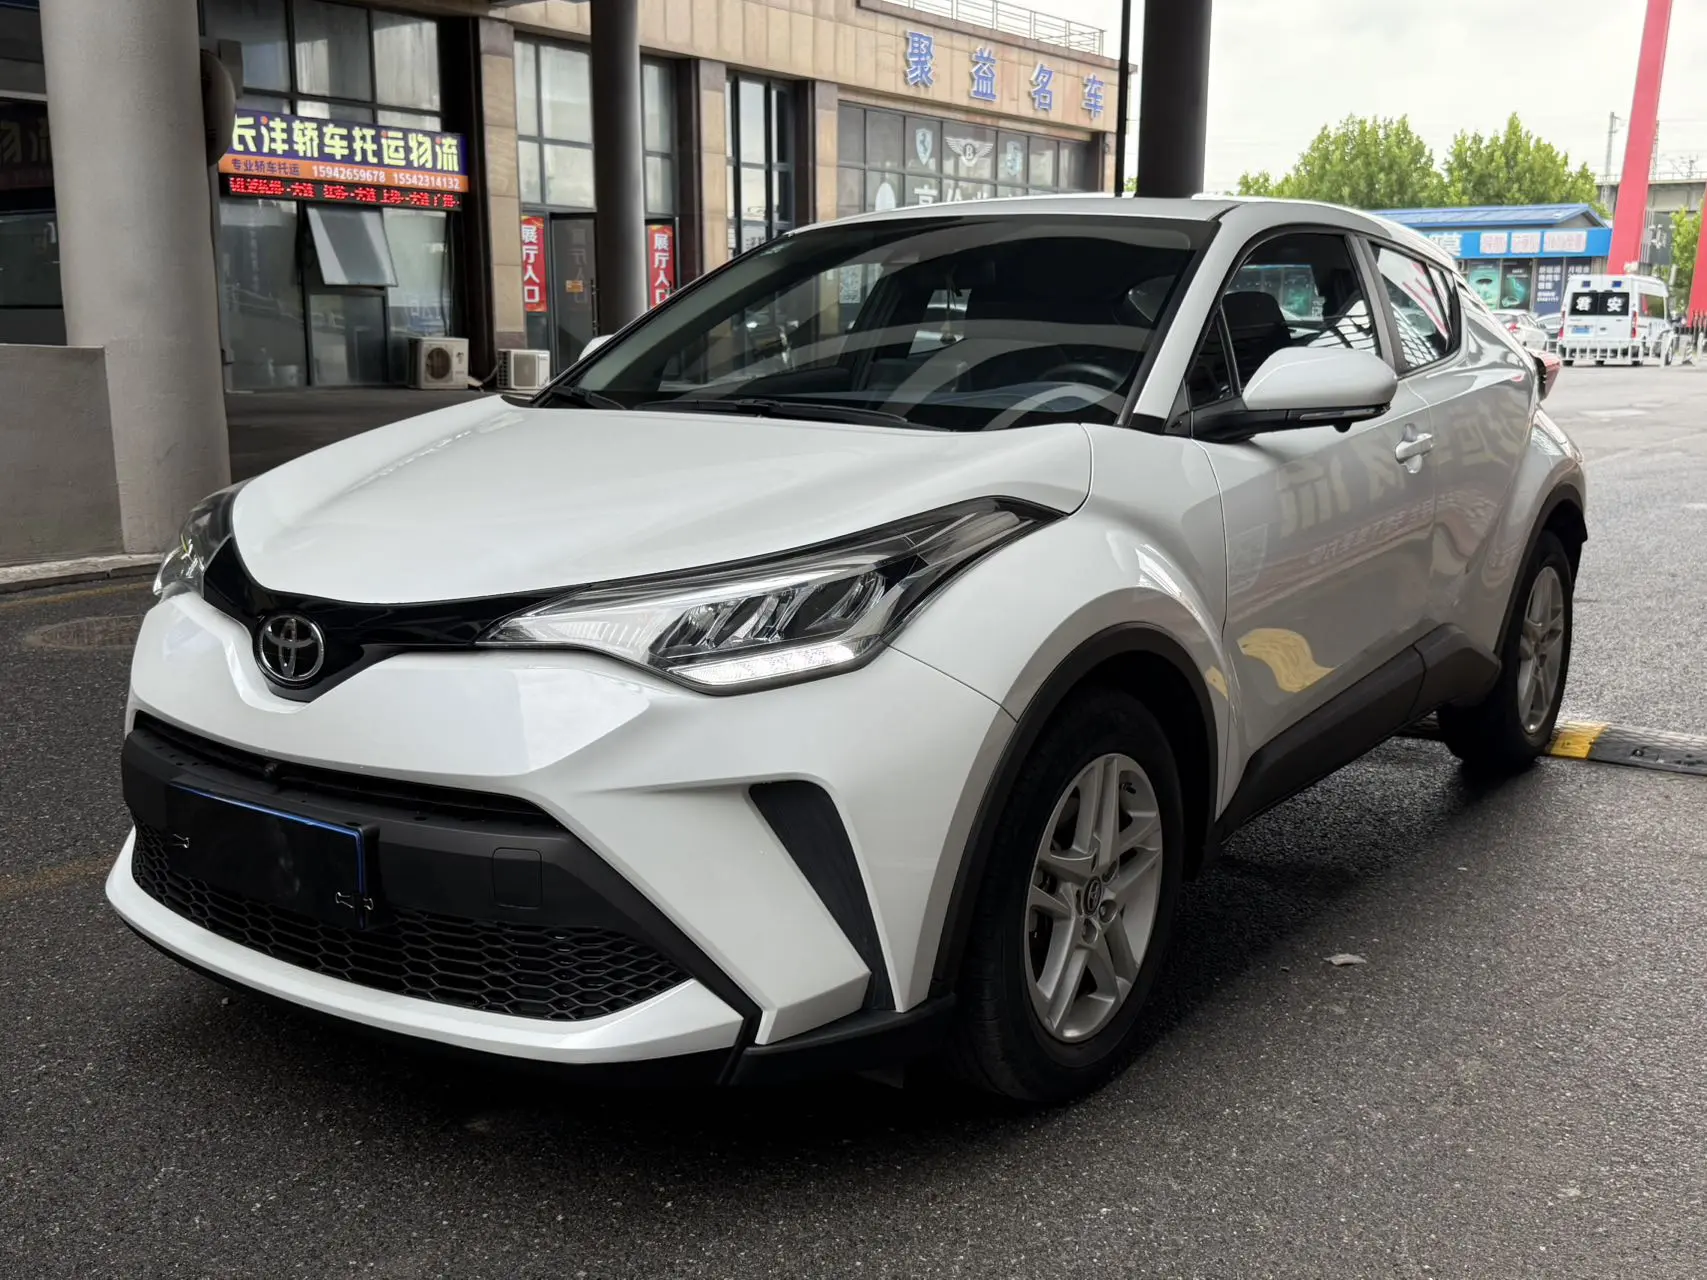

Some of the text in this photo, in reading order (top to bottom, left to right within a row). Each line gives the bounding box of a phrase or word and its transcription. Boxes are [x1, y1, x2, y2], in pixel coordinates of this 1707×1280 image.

[906, 31, 1104, 118] 聚益名车
[231, 158, 460, 190] 专业轿车托运 15942659678 15542314132
[521, 224, 540, 303] 展厅入口
[654, 233, 670, 306] 展厅入口
